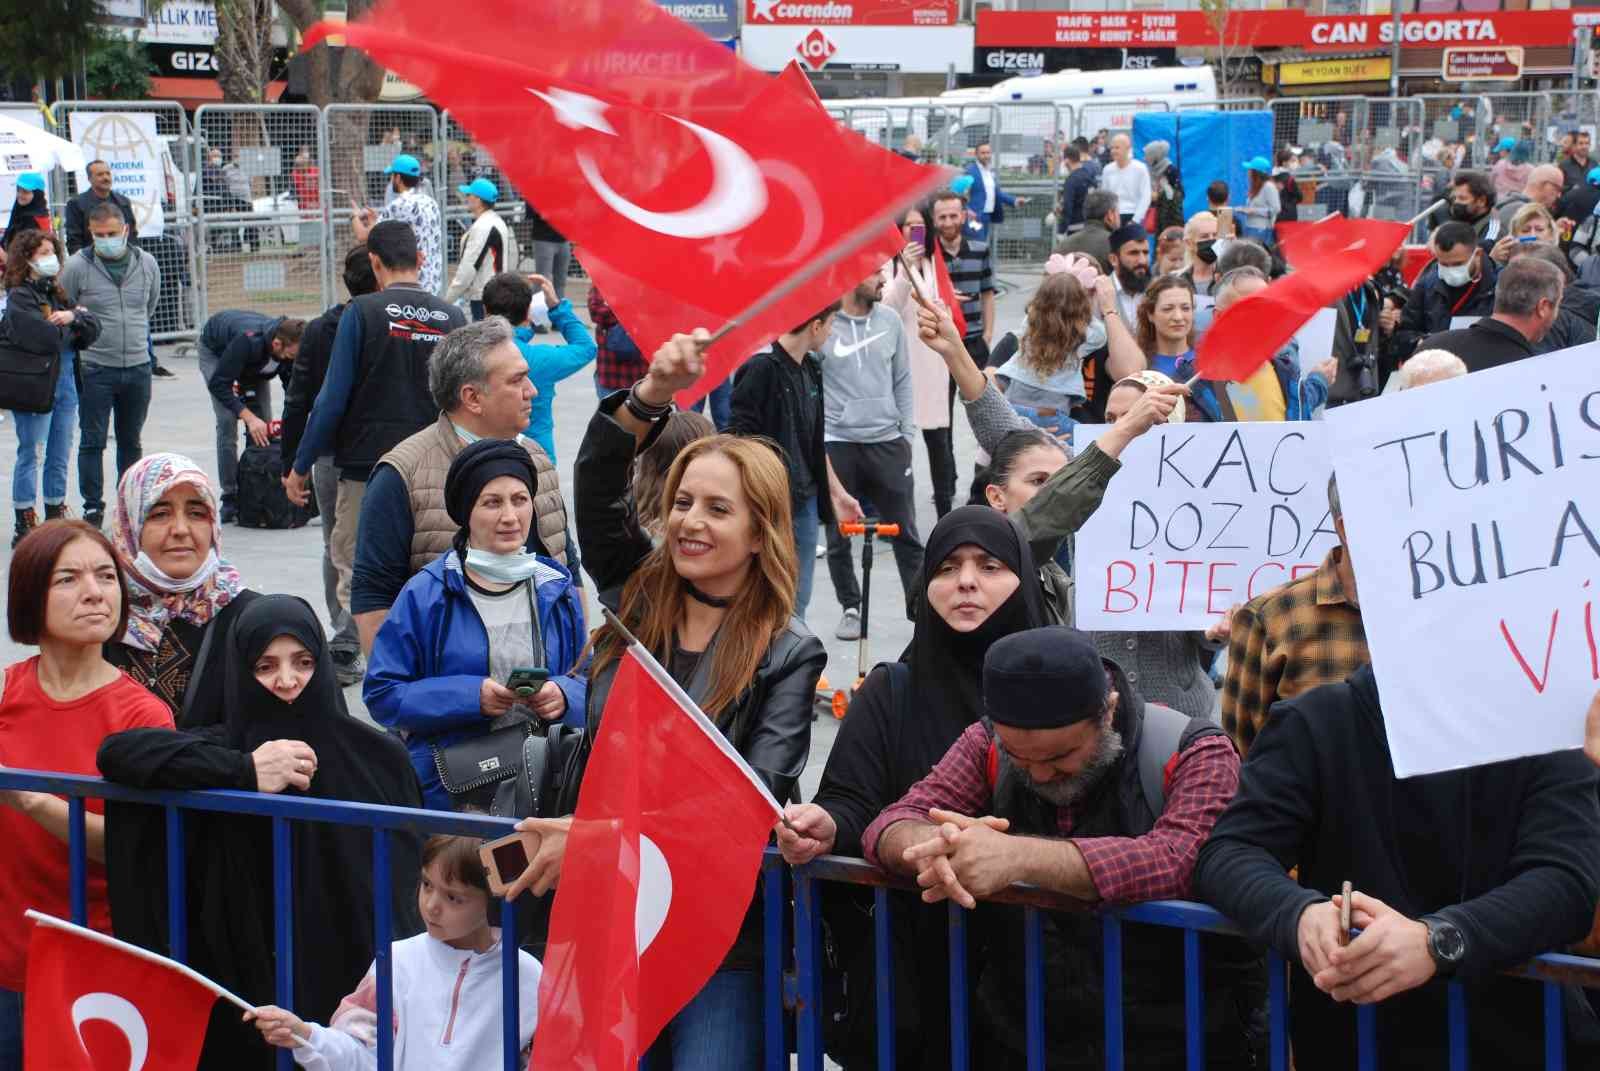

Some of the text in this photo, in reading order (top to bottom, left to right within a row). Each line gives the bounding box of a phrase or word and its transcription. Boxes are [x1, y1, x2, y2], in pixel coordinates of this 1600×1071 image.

[777, 1, 853, 18] corendon
[1311, 21, 1367, 43] CAN
[1402, 501, 1600, 600] BULA
